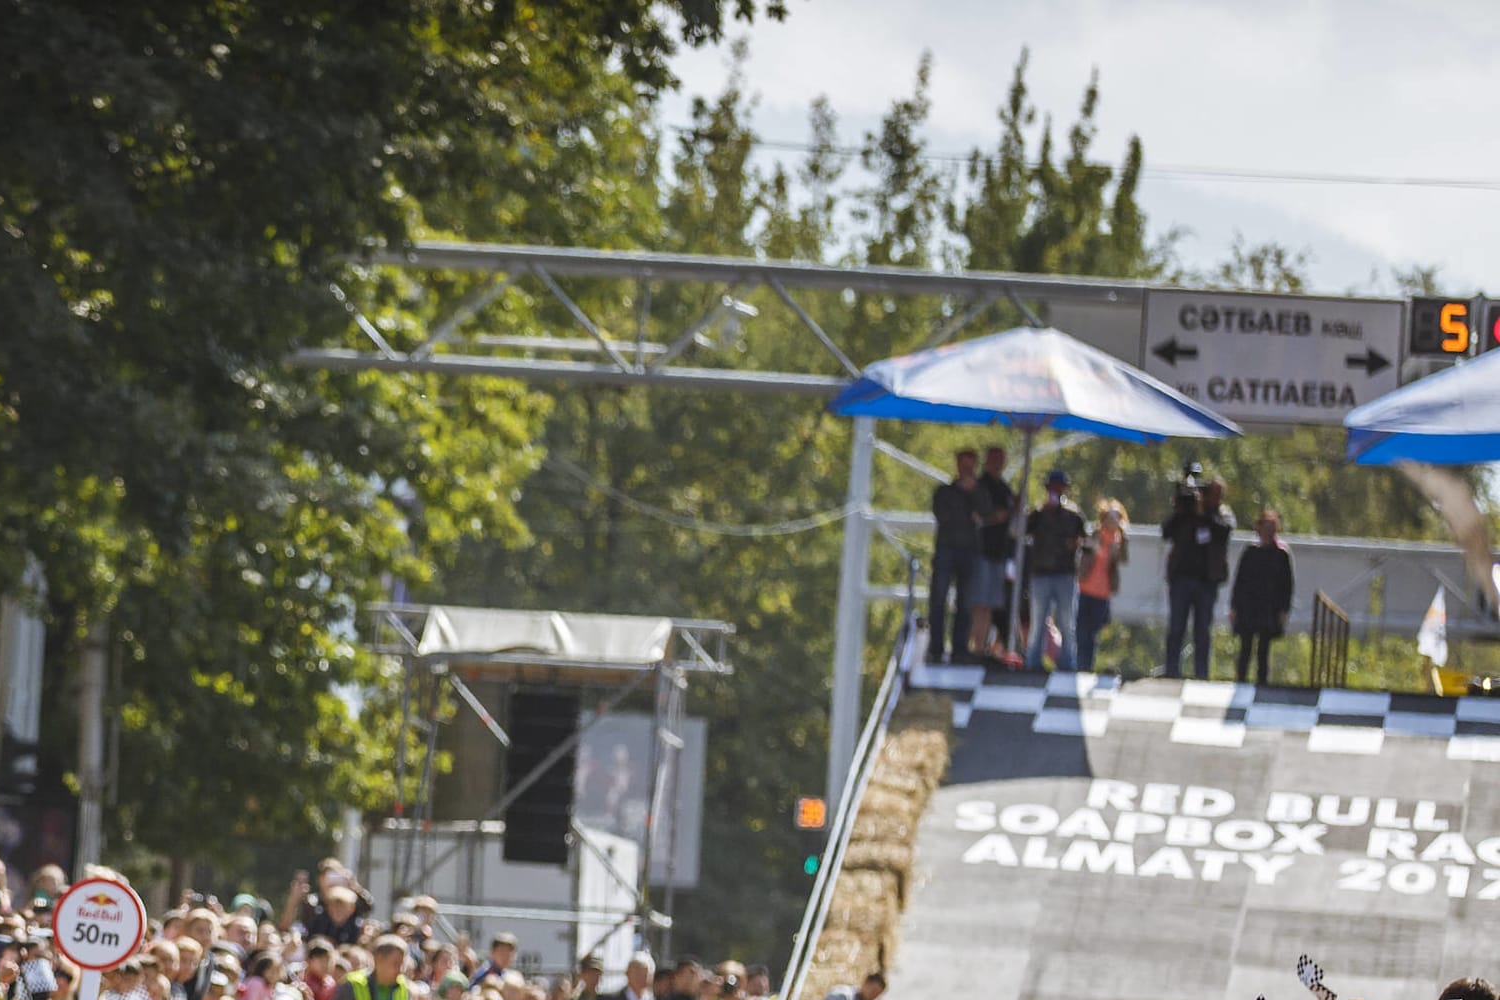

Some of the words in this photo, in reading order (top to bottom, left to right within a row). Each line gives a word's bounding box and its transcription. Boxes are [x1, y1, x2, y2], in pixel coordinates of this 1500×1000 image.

[1207, 375, 1357, 408] САТПАЕВА
[955, 799, 1330, 856] SOAPBOX
[1088, 778, 1236, 817] RED
[1266, 790, 1451, 832] BULL
[962, 833, 1296, 885] ALMATY
